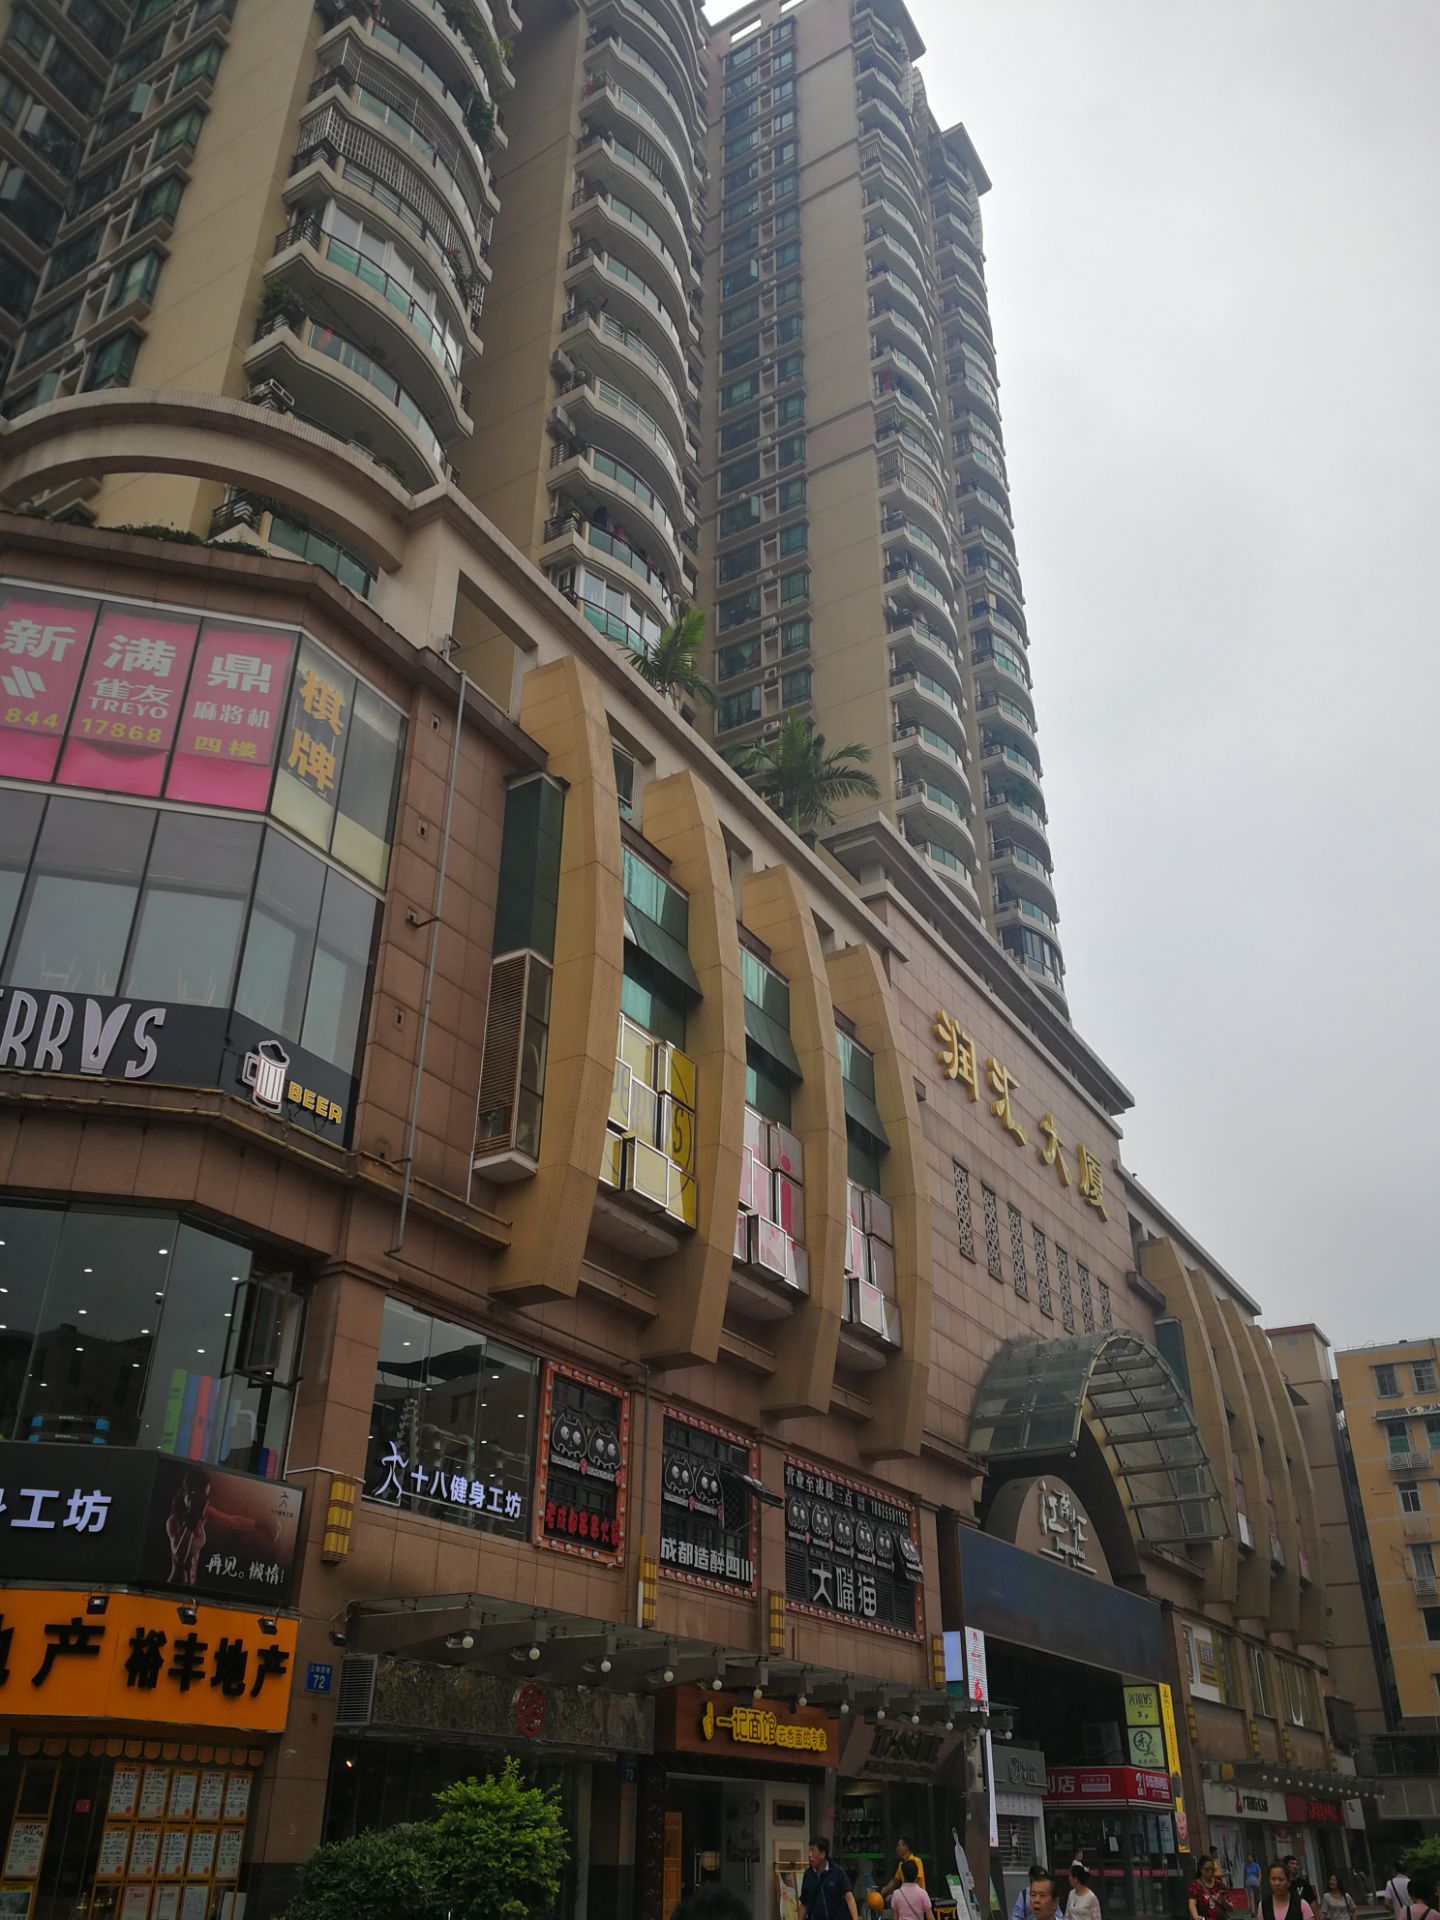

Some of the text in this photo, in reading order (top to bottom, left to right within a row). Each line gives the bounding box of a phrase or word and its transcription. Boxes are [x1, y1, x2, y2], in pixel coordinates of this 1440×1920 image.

[89, 695, 168, 719] TREYO
[92, 678, 173, 706] 雀友
[81, 718, 161, 743] 17868
[192, 701, 271, 729] 麻将机
[288, 671, 345, 793] 棋牌
[195, 736, 257, 759] 四楼
[287, 1080, 342, 1125] BEER
[932, 1008, 1111, 1222] 润汇大厦
[0, 1487, 112, 1533] 工坊
[410, 1464, 522, 1519] 十八健身工坊
[660, 1537, 754, 1583] 成都造醉四川
[125, 1627, 290, 1697] 裕丰地产
[312, 1674, 326, 1690] 72
